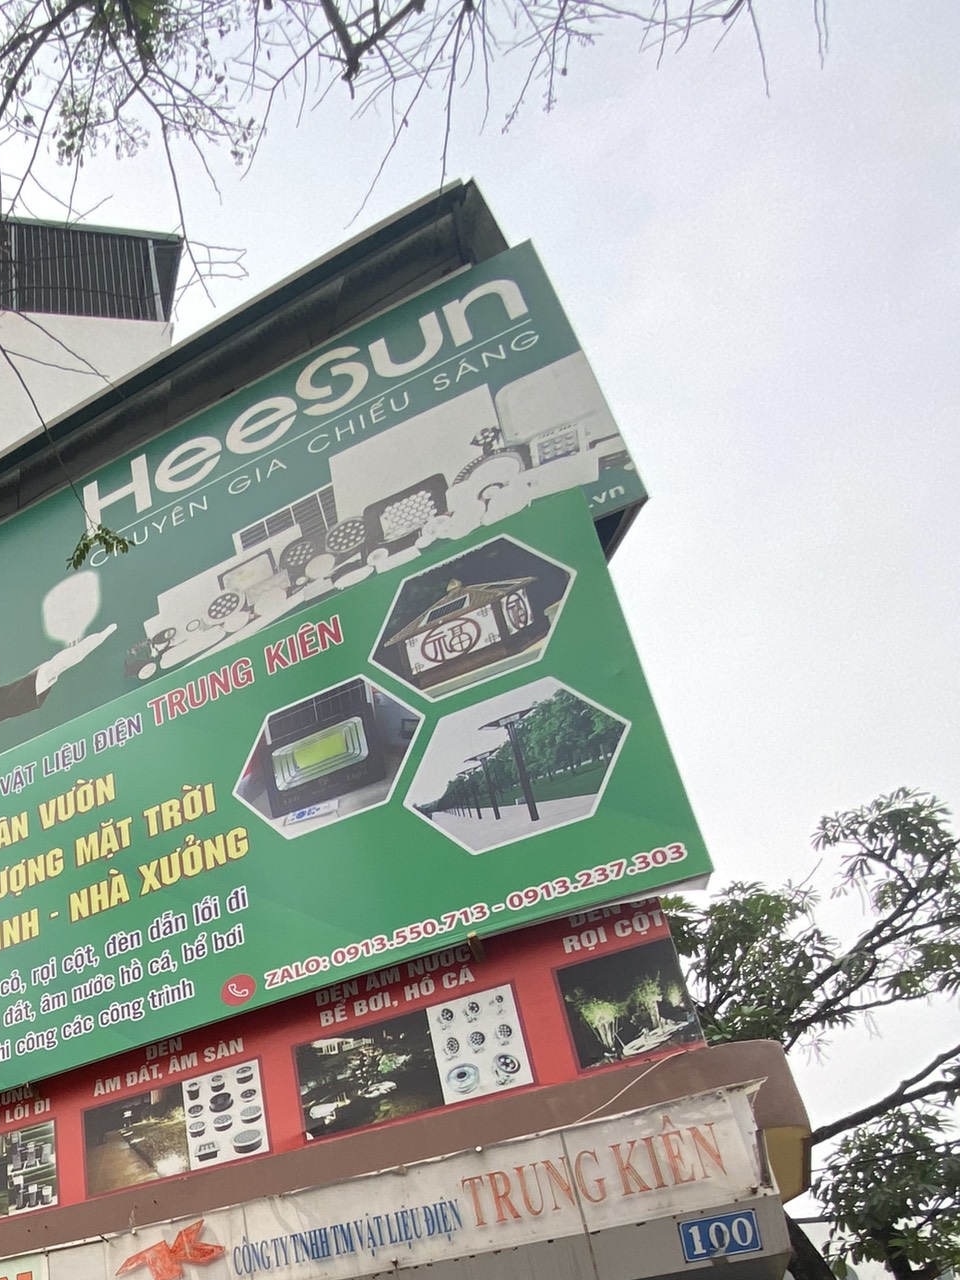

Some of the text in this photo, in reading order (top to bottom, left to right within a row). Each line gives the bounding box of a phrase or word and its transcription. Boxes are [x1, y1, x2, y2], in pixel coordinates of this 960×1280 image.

[83, 279, 528, 537] HeeSun
[228, 458, 286, 495] GIA
[307, 391, 410, 454] CHIẾU
[434, 330, 540, 391] SÁNG
[0, 762, 37, 796] VẬT
[43, 740, 86, 777] LIỆU
[94, 714, 142, 753] ĐIỆN
[148, 657, 254, 726] TRUNG
[264, 614, 343, 675] KIÊN
[38, 773, 116, 830] VƯỜN
[74, 816, 132, 868] MẶT
[143, 782, 216, 838] TRỜI
[69, 868, 130, 924] NHÀ
[138, 827, 250, 896] XƯỞNG
[264, 842, 687, 989] ZALO: 0913.550.713 0913.237.303
[0, 969, 26, 997] cỏ,
[31, 957, 56, 986] rọi
[62, 946, 100, 974] cột,
[105, 929, 142, 957] đèn
[148, 909, 187, 942] dẫn
[193, 895, 221, 926] lối
[227, 886, 248, 912] đi
[4, 999, 36, 1027] đất,
[40, 990, 67, 1015] âm
[72, 973, 116, 1004] nước
[120, 959, 142, 986] hồ
[149, 951, 177, 977] cá,
[183, 933, 207, 965] bể
[212, 924, 244, 954] bơi
[562, 909, 664, 954] RỌI CỘT
[16, 1026, 58, 1055] công
[62, 1016, 94, 1040] các
[99, 997, 144, 1028] công
[149, 979, 195, 1010] trình
[319, 964, 476, 1027] BỂ BƠI, HỒ CÁ
[5, 1104, 29, 1124] LỐI
[34, 1099, 51, 1115] ĐI
[94, 1038, 244, 1097] ÂM ĐẤT, ÂM SÀN
[233, 1114, 728, 1275] CÔNG TNHH ĐIỆN TRUNG KIÊN
[688, 1216, 754, 1256] 100
